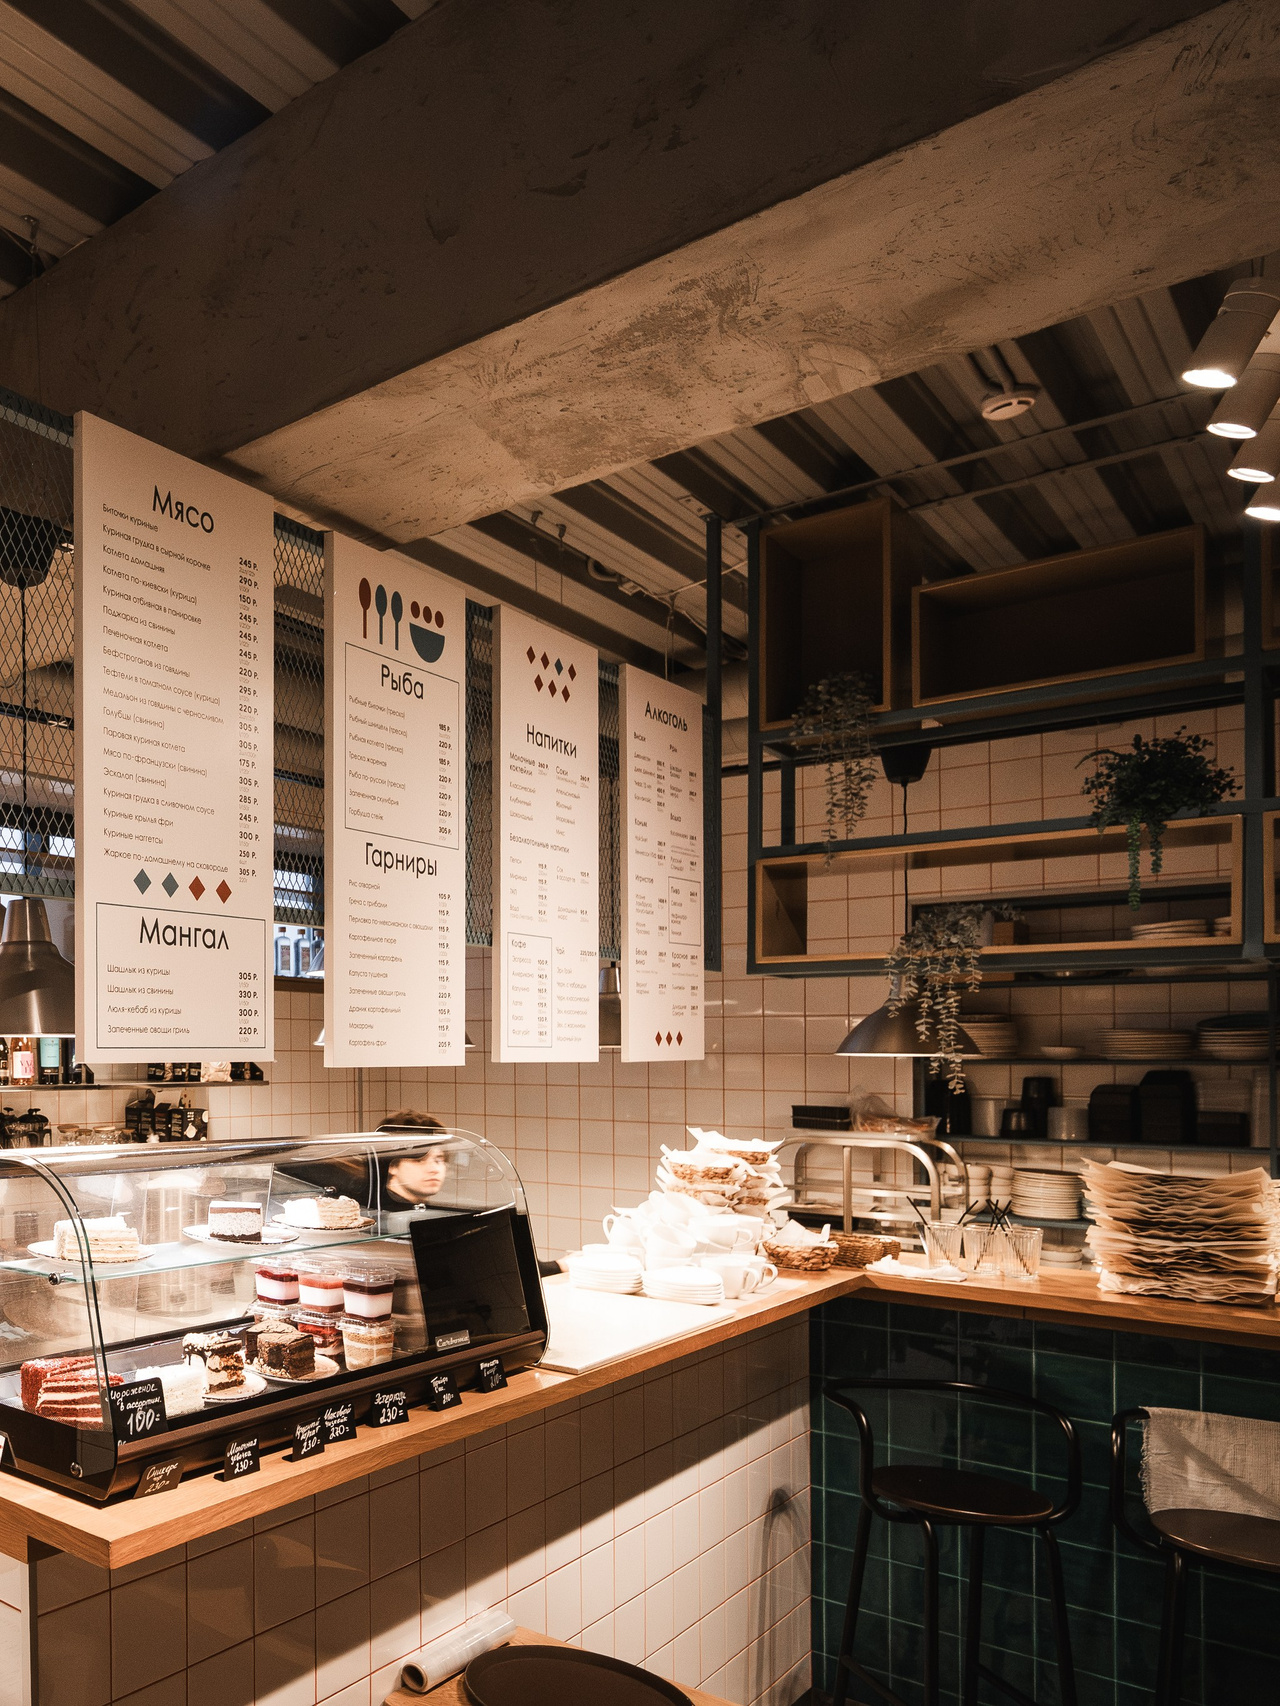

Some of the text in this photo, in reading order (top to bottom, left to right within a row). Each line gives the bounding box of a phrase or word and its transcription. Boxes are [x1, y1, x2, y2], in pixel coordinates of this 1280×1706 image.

[152, 485, 215, 533] Мясо
[382, 664, 423, 699] Рыба
[645, 701, 687, 731] Алкоголь
[526, 723, 577, 758] Напитки
[365, 843, 437, 878] Гарниры
[140, 916, 229, 950] Мангал
